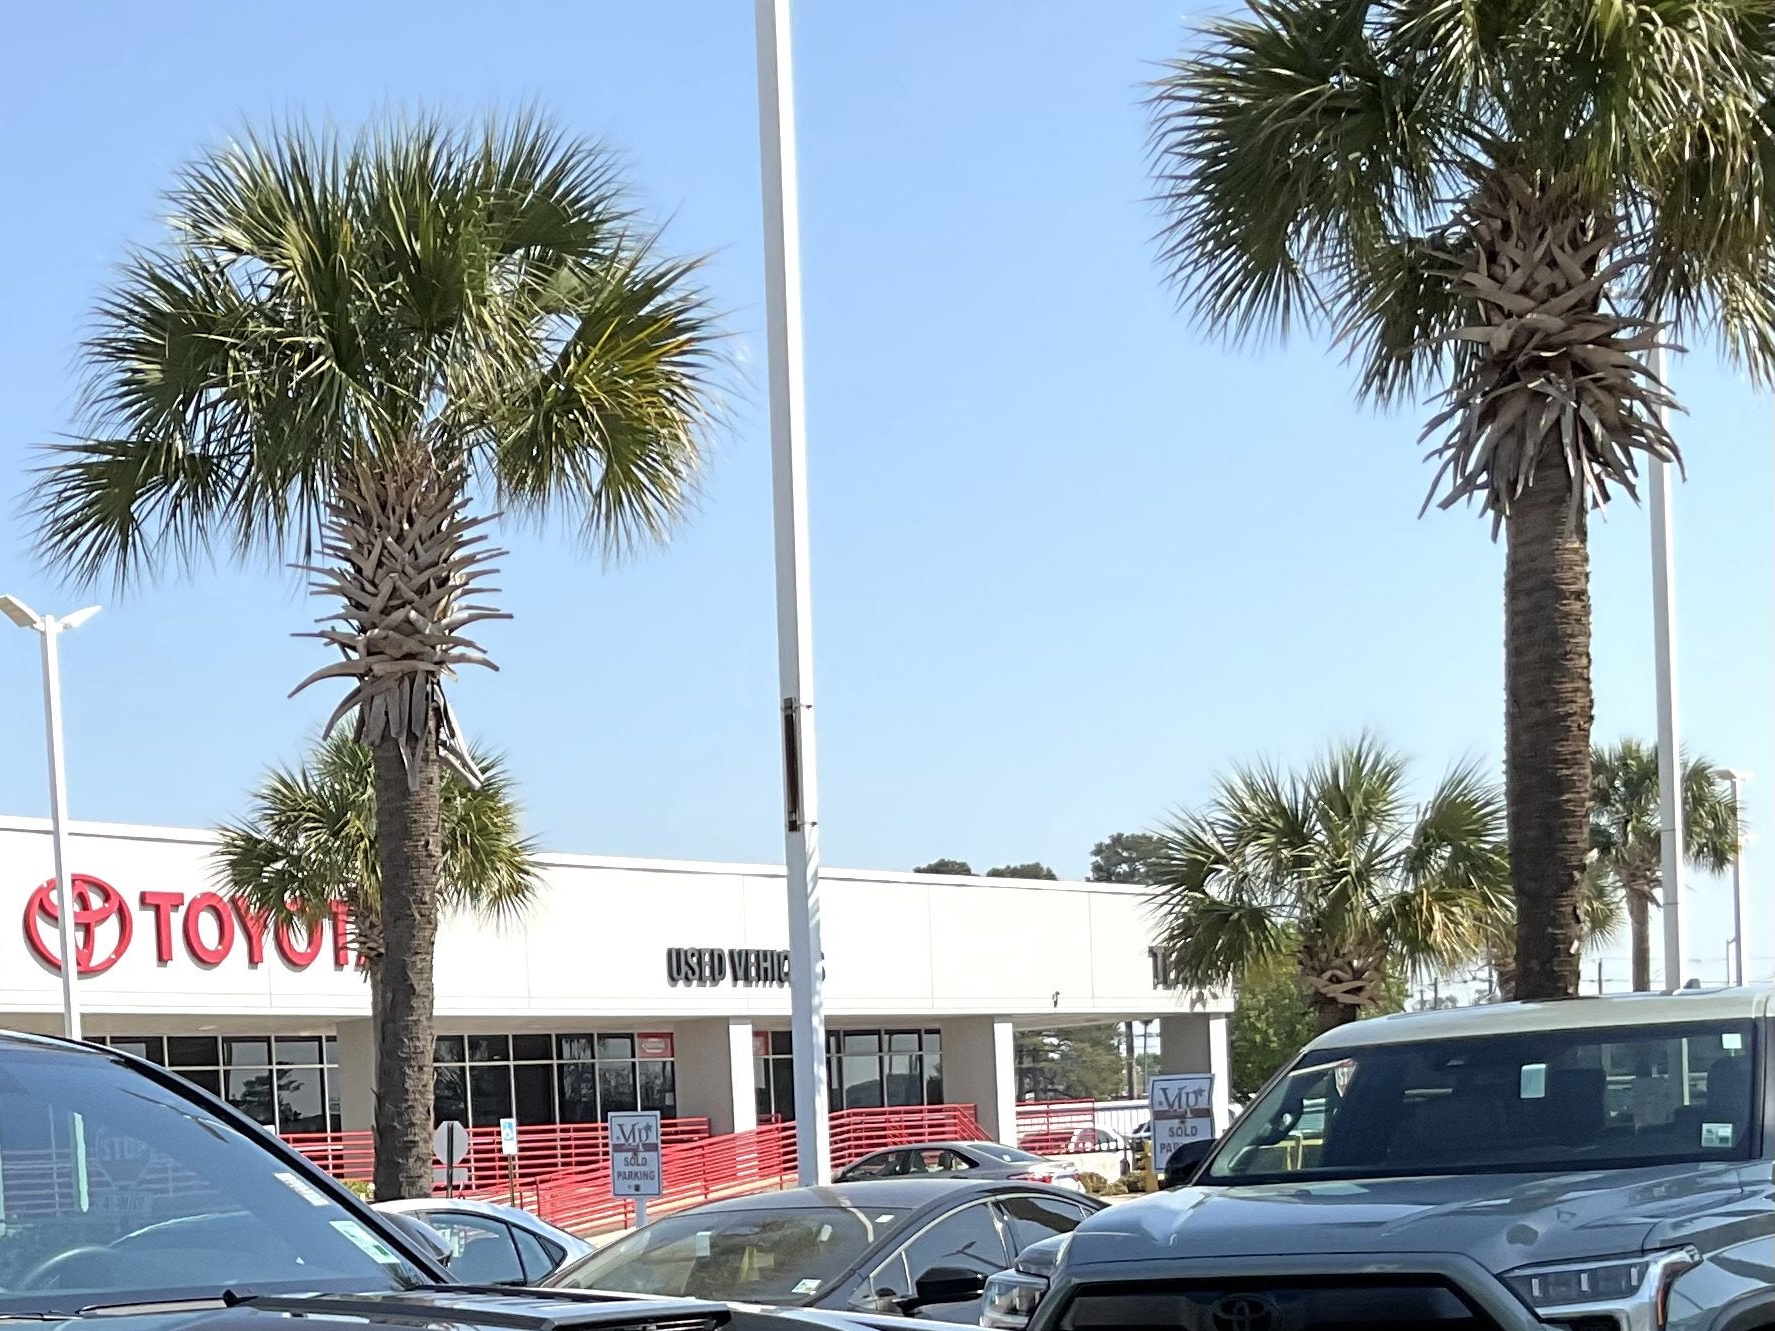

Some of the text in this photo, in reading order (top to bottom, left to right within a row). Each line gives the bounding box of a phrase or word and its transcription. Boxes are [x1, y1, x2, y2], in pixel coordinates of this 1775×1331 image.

[139, 890, 368, 969] TOYOT
[666, 947, 826, 985] USED VEHIC
[1168, 1125, 1198, 1138] SOLD
[623, 1156, 647, 1167] SOLD
[616, 1170, 656, 1181] PARKING
